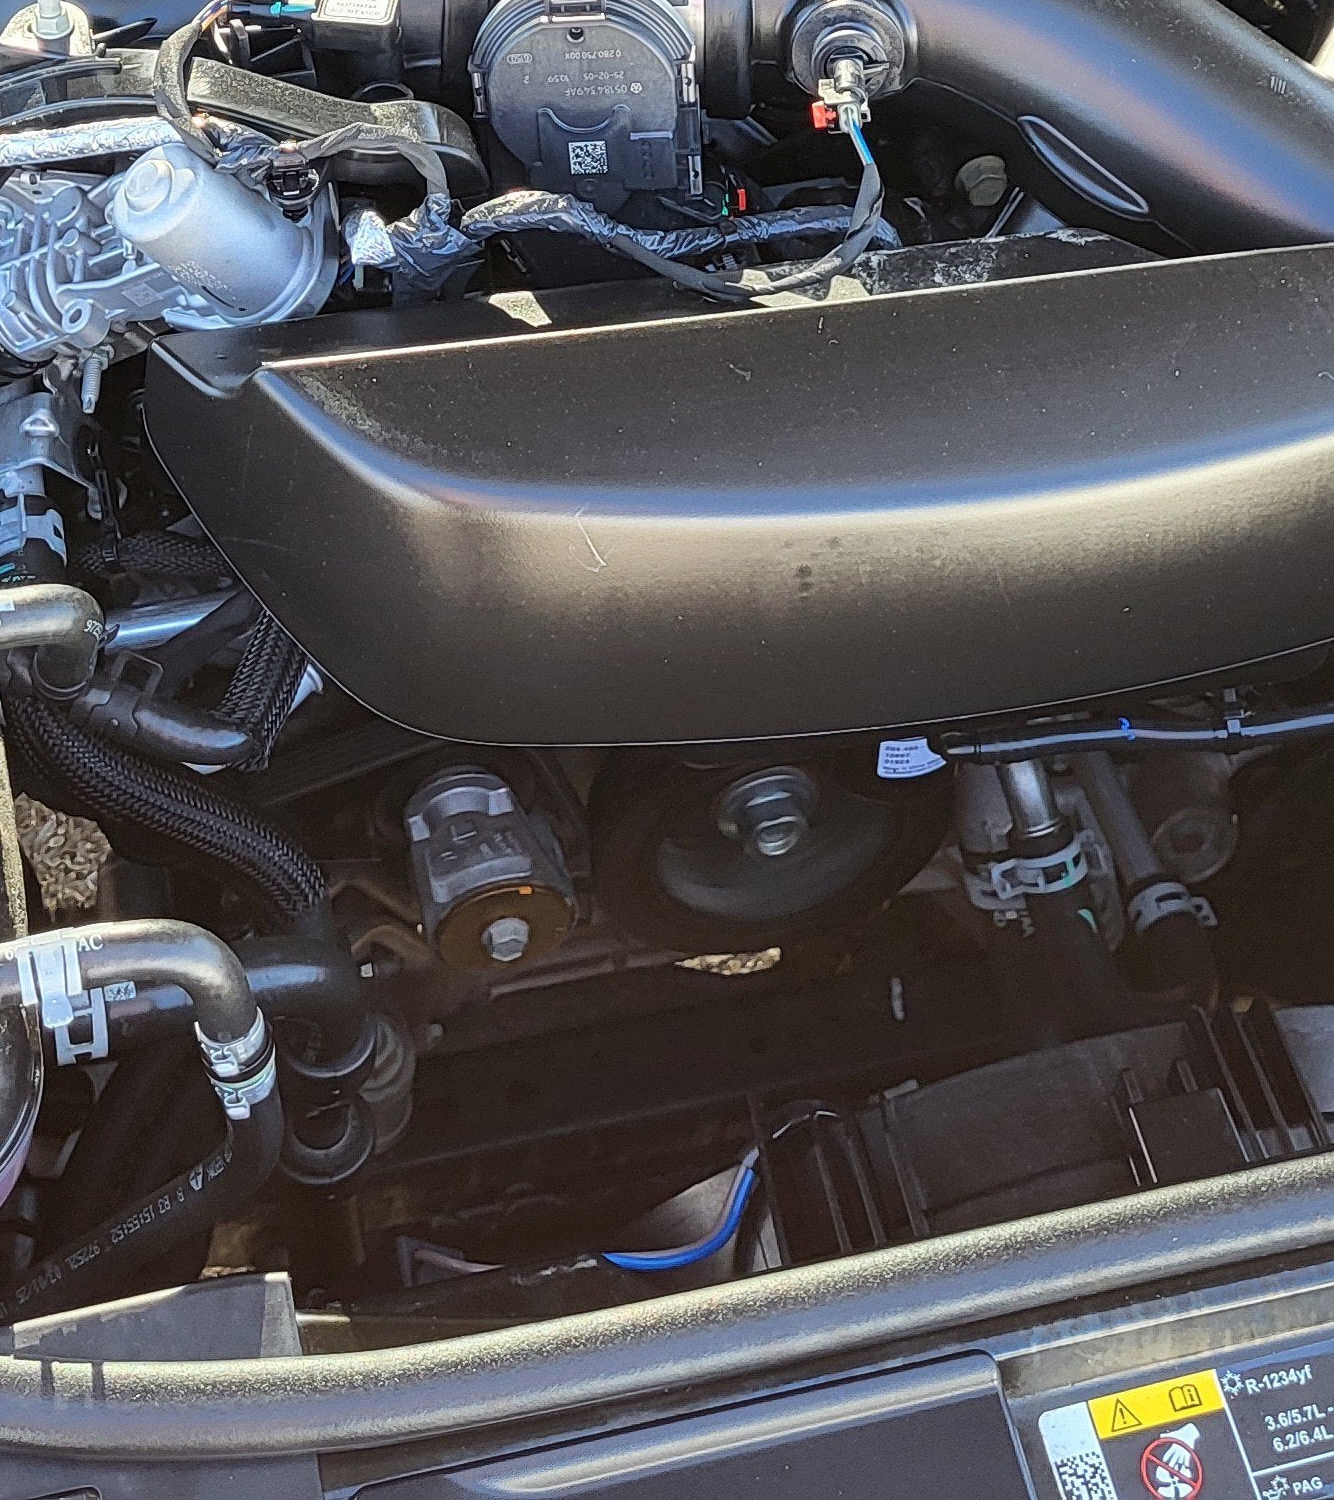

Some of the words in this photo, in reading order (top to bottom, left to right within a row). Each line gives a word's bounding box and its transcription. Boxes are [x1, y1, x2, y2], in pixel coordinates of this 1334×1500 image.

[583, 70, 625, 81] 25-02-05
[565, 84, 628, 97] 05184349AF
[1245, 1364, 1314, 1395] R-1234yf
[1264, 1404, 1326, 1431] 3.6/5.7L
[1272, 1423, 1334, 1453] 6.2/6.4L
[1292, 1476, 1324, 1496] PAG
